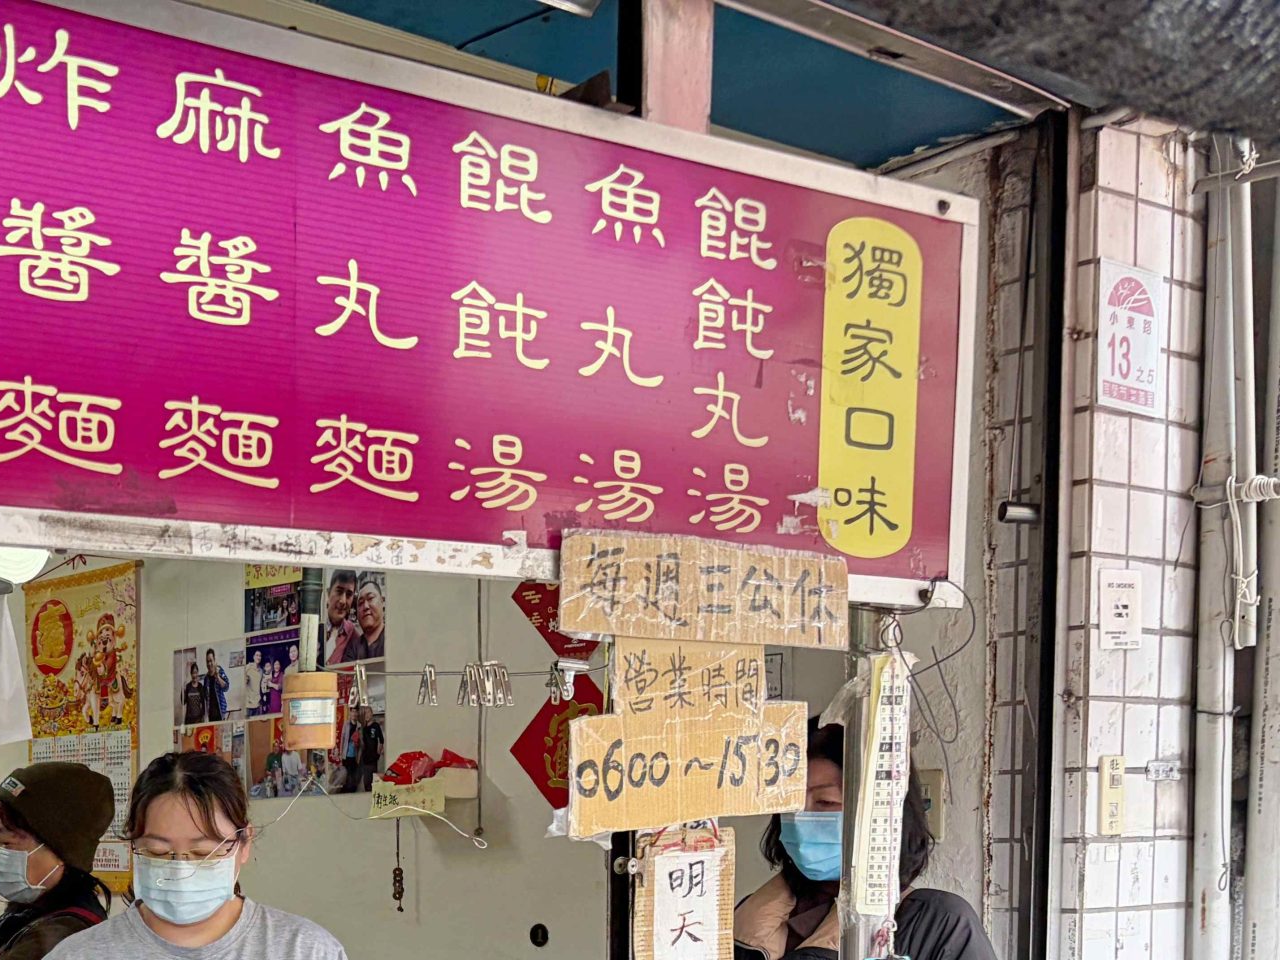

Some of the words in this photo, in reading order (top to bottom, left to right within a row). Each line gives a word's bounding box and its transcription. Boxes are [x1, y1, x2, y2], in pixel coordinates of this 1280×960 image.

[157, 68, 281, 489] 麻醬麵
[310, 102, 420, 502] 魚丸麵
[448, 130, 553, 512] 餛飩湯
[572, 163, 666, 523] 魚丸湯
[686, 186, 779, 534] 餛飩丸湯
[831, 240, 909, 537] 獨家口味
[1107, 332, 1131, 380] 13
[579, 543, 840, 641] 每週三公休
[623, 646, 760, 714] 營業時間
